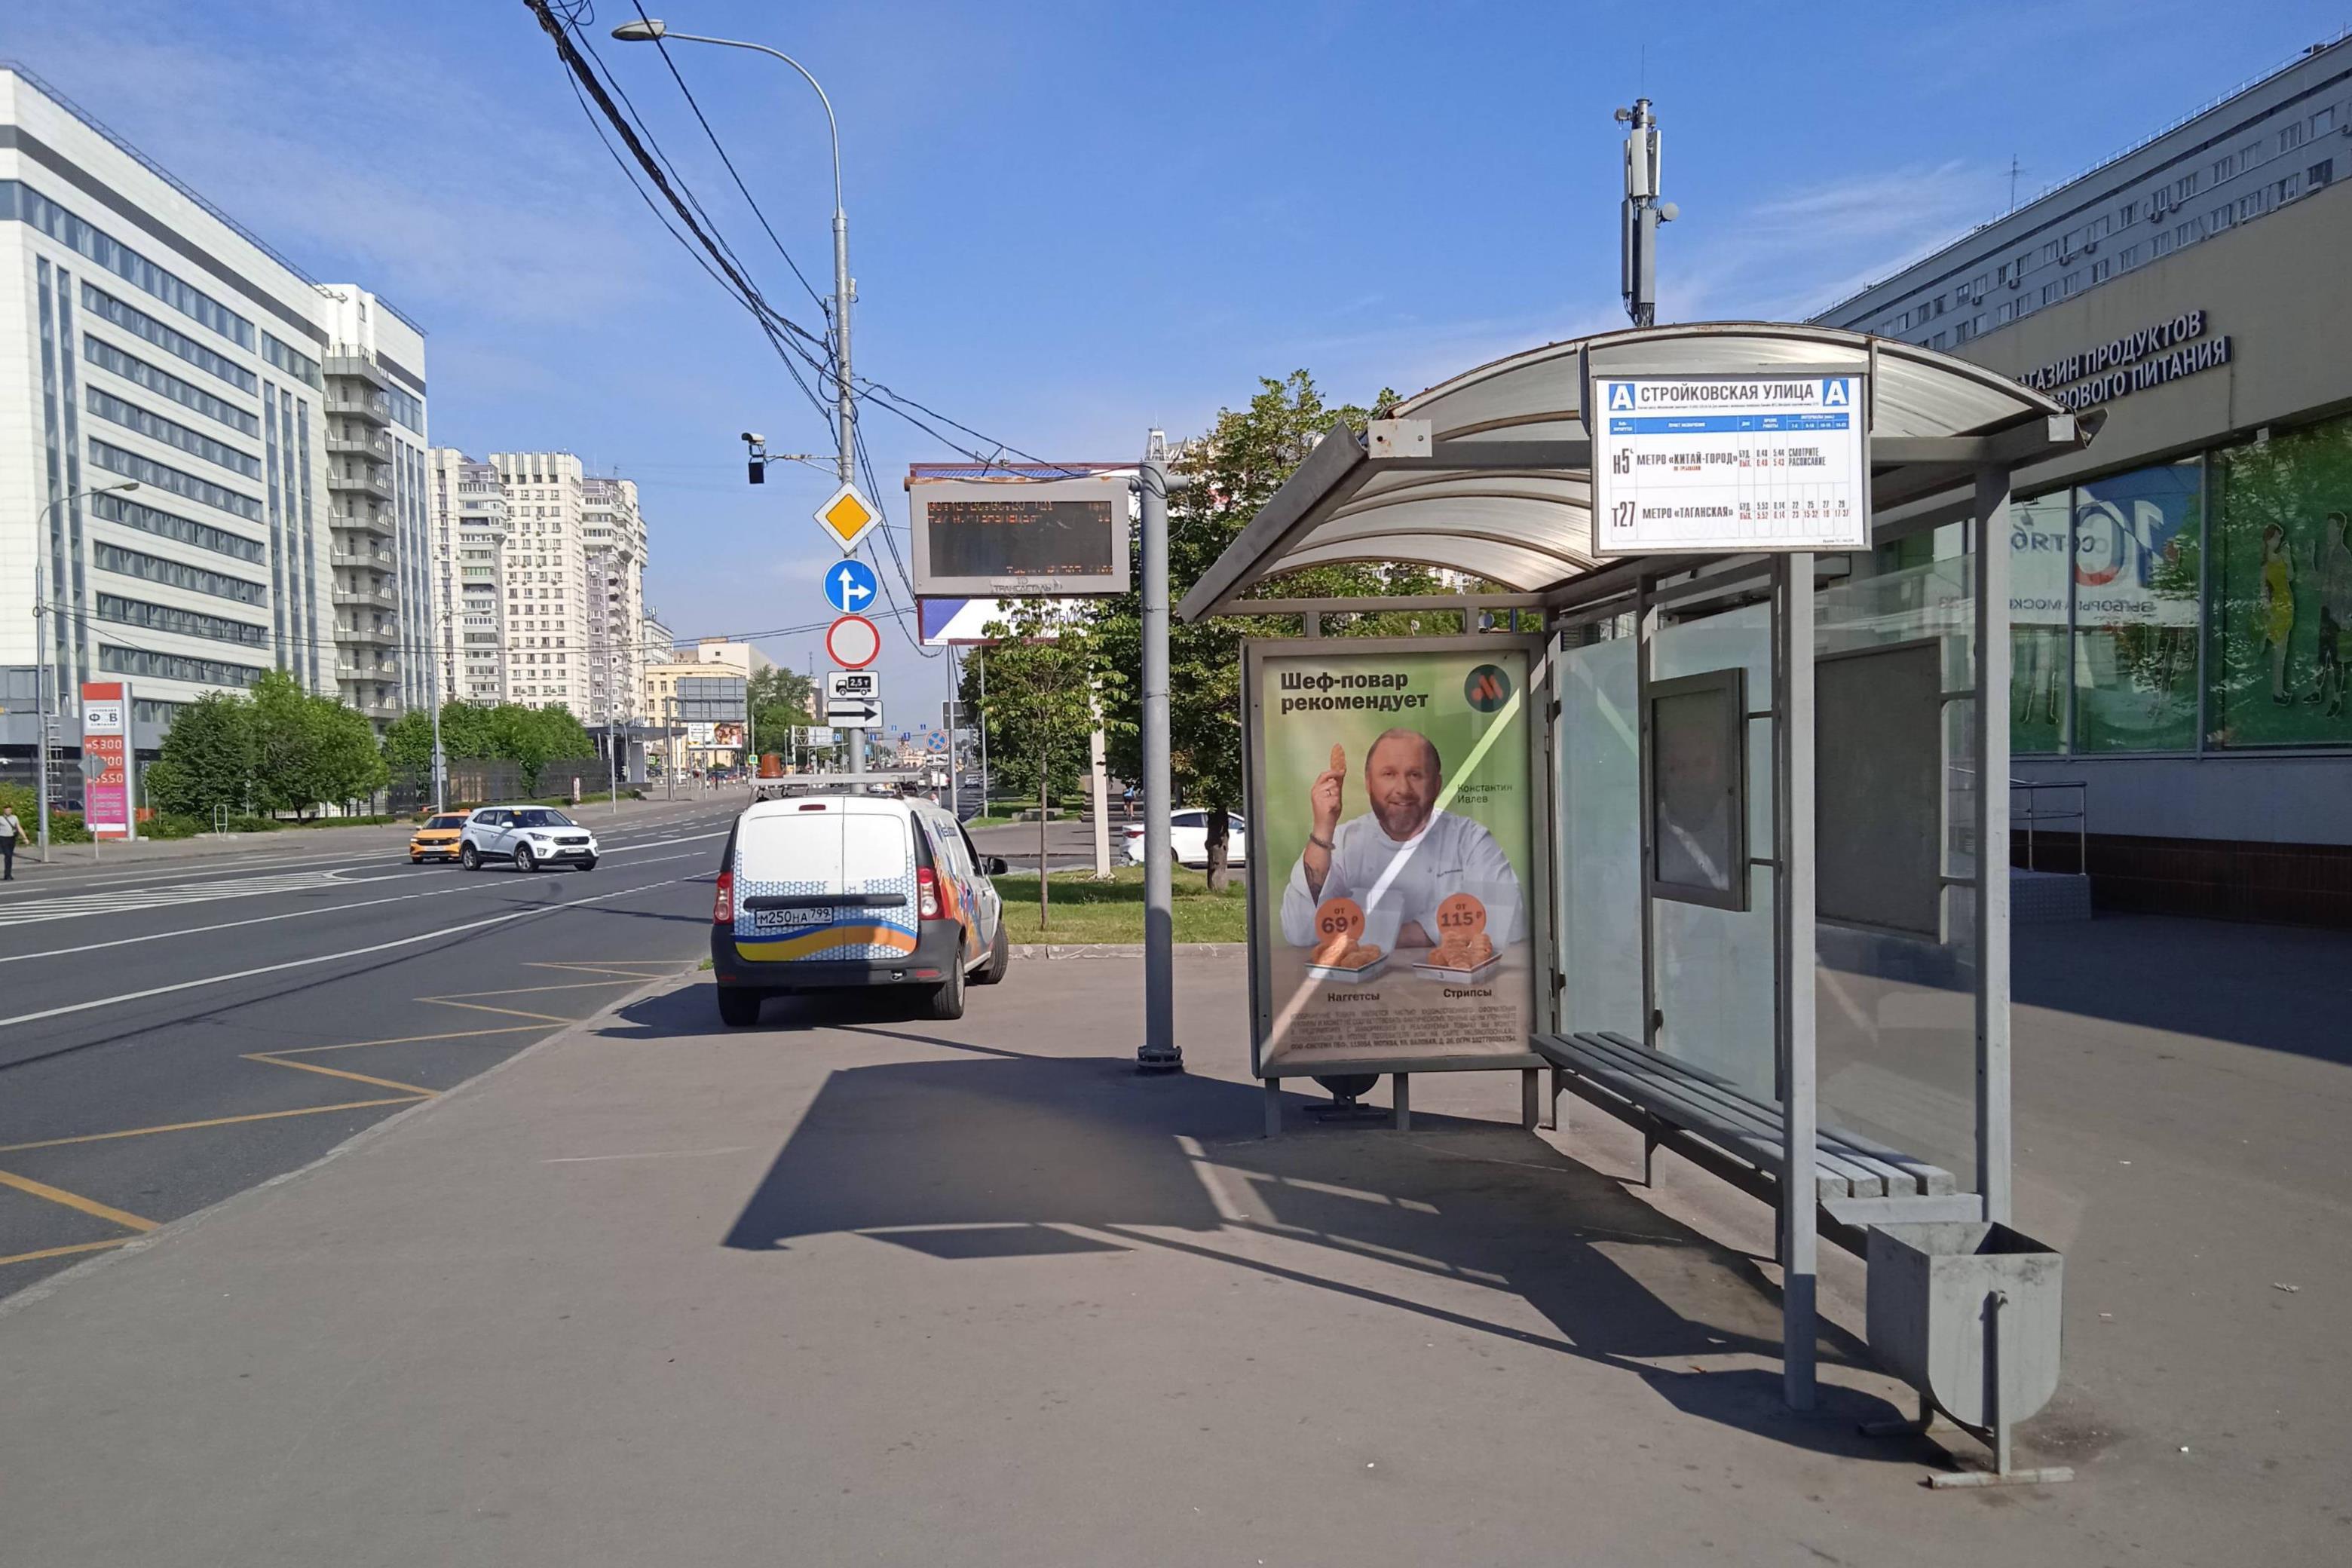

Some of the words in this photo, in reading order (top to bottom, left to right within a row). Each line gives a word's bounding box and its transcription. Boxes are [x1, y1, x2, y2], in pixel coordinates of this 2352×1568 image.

[2014, 355, 2079, 390] АГАЗИН
[2086, 309, 2203, 375] ПРОДУКТОВ
[2050, 371, 2126, 409] РОВОГО
[2132, 335, 2228, 391] ПИТАНИЯ
[1610, 384, 1634, 410] А
[1641, 383, 1759, 402] СТРОЙКОВСКАЯ
[1763, 383, 1815, 400] УЛИЦА
[1824, 379, 1848, 406] А
[1613, 448, 1630, 474] Н5
[1637, 454, 1667, 465] МЕТРО
[1612, 501, 1635, 527] Т27
[1643, 507, 1672, 519] МЕТРО
[1674, 506, 1733, 518] «ТАГАНСКАЯ»
[850, 678, 862, 687] 2,5
[1281, 672, 1408, 692] Шеф-повар
[1282, 694, 1429, 714] рекомендует
[1457, 783, 1513, 793] Константин
[1328, 992, 1380, 1002] Наггетсы
[1443, 988, 1492, 999] Стрипсы
